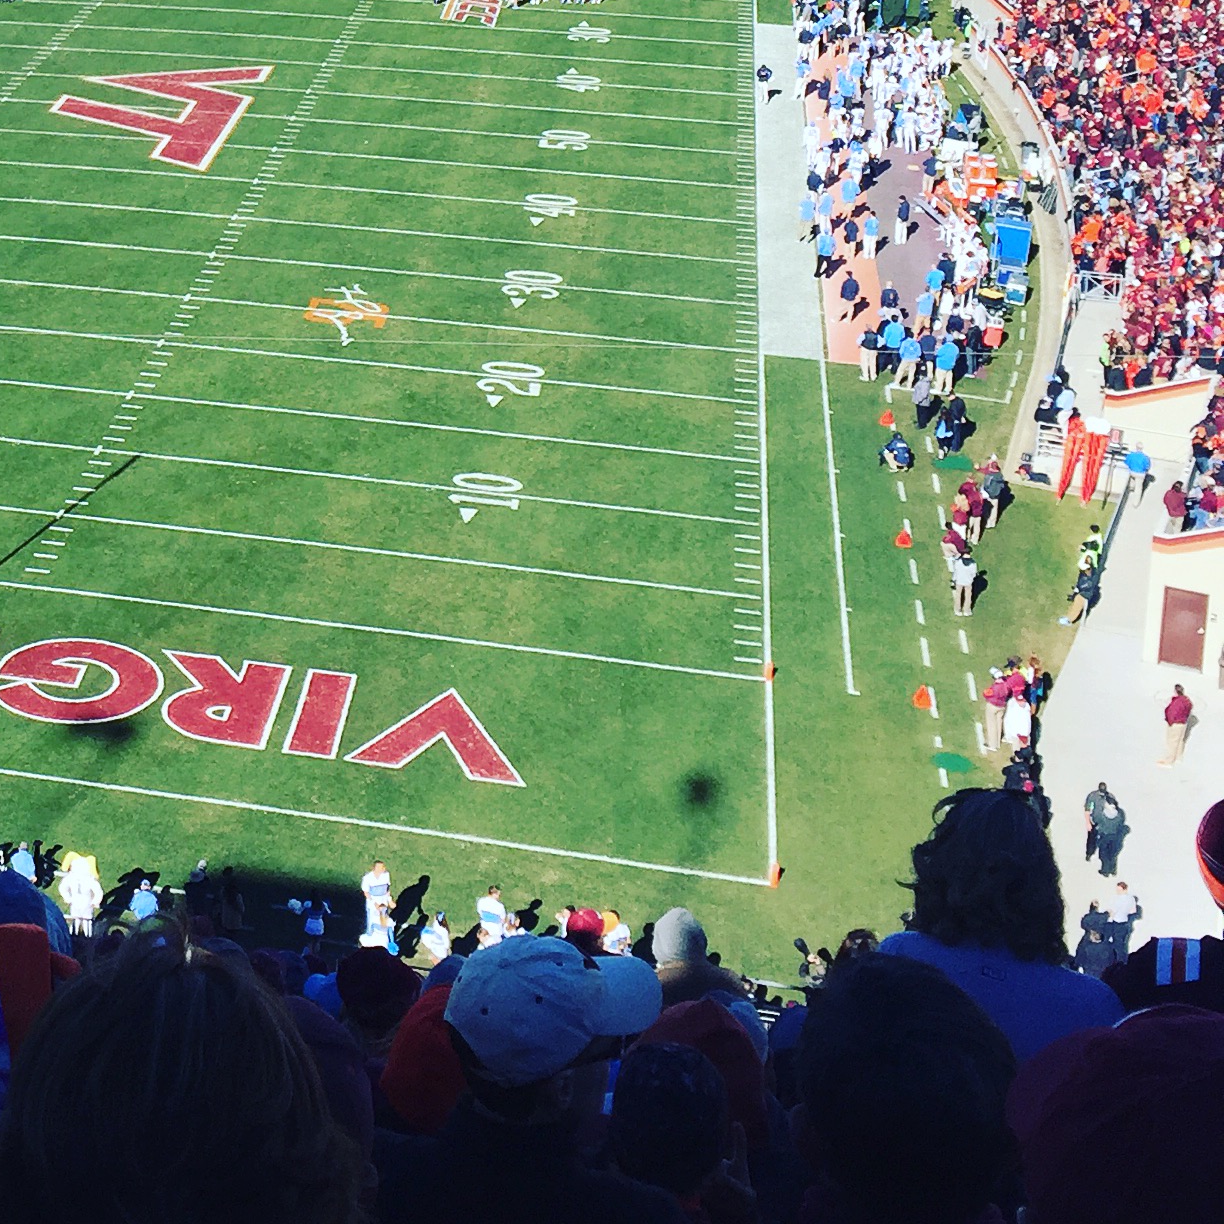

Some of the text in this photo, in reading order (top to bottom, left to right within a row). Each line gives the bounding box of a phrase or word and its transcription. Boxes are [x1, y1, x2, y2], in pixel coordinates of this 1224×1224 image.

[556, 75, 602, 93] 40
[48, 65, 276, 172] VT
[538, 129, 591, 151] 50
[524, 194, 578, 218] 40
[501, 270, 563, 300] 30
[476, 361, 545, 397] 20
[448, 472, 524, 510] 10
